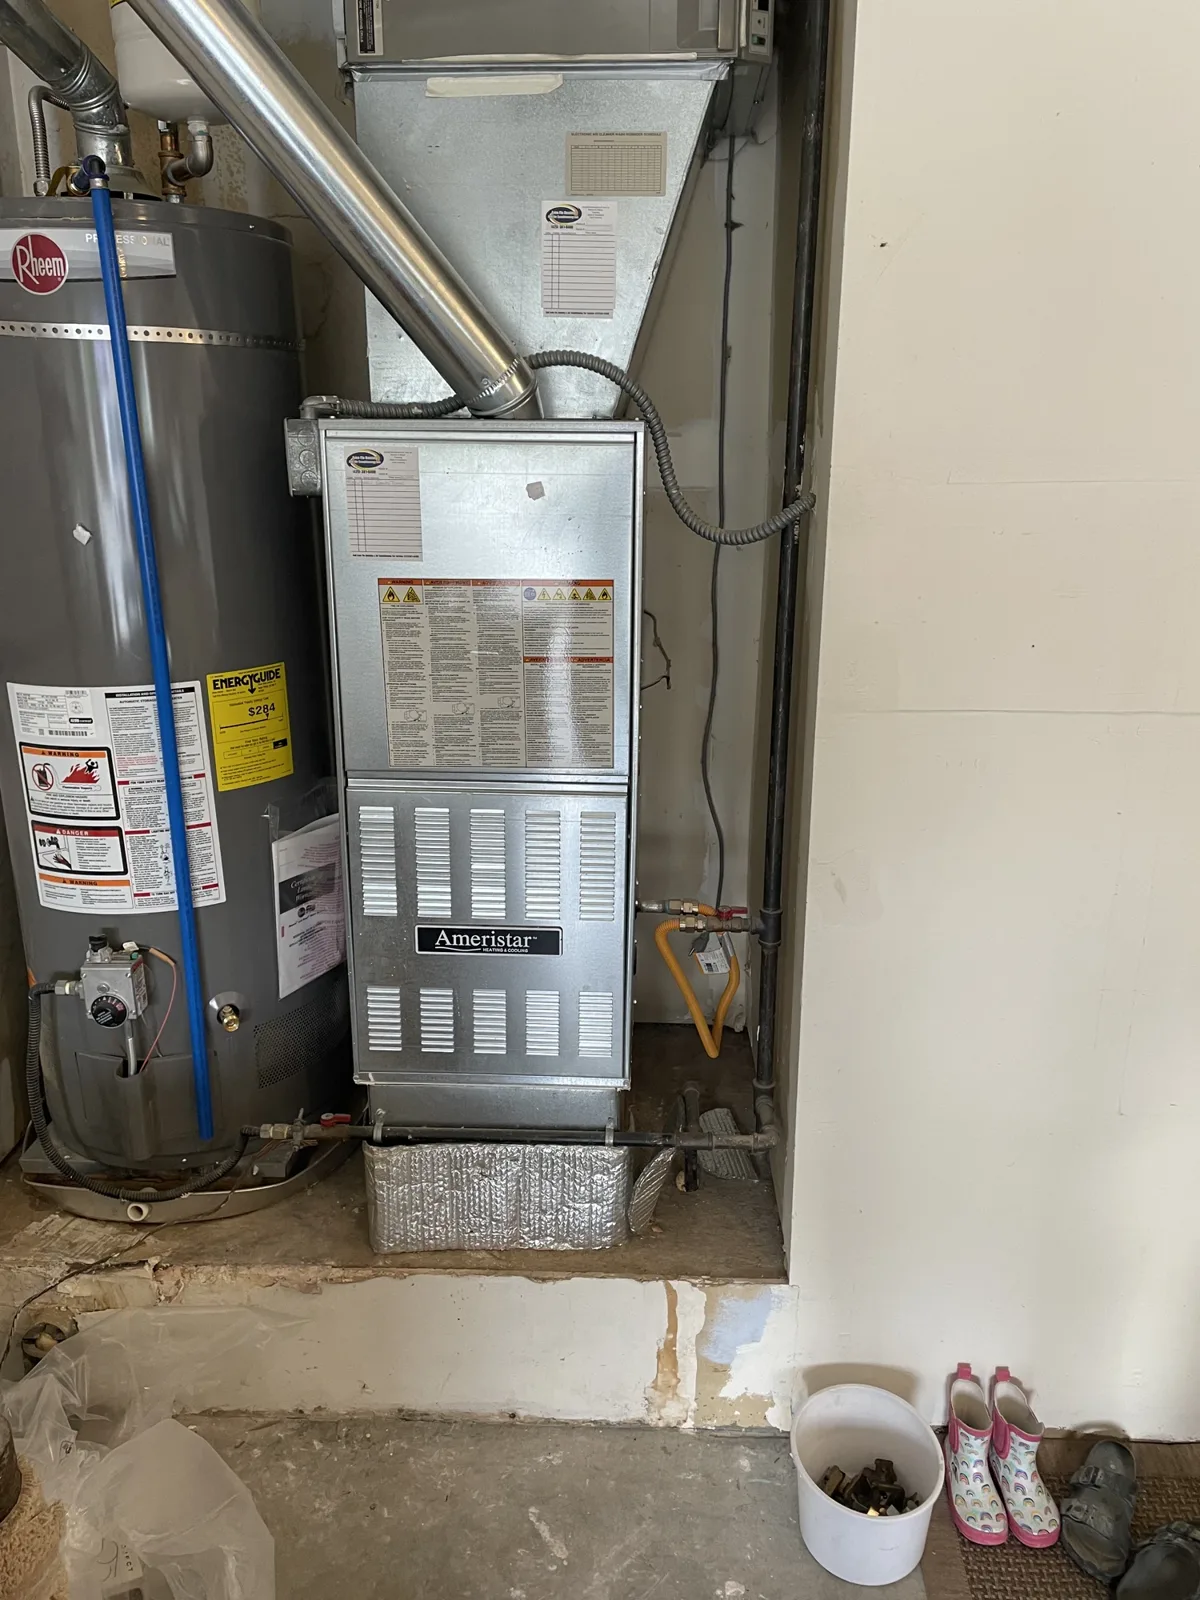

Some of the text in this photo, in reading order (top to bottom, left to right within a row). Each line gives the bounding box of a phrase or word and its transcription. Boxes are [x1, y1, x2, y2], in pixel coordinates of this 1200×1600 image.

[16, 235, 65, 285] Rheem
[212, 668, 281, 692] ENERGYGUIDE
[248, 703, 276, 717] $284
[434, 929, 532, 948] Ameristar
